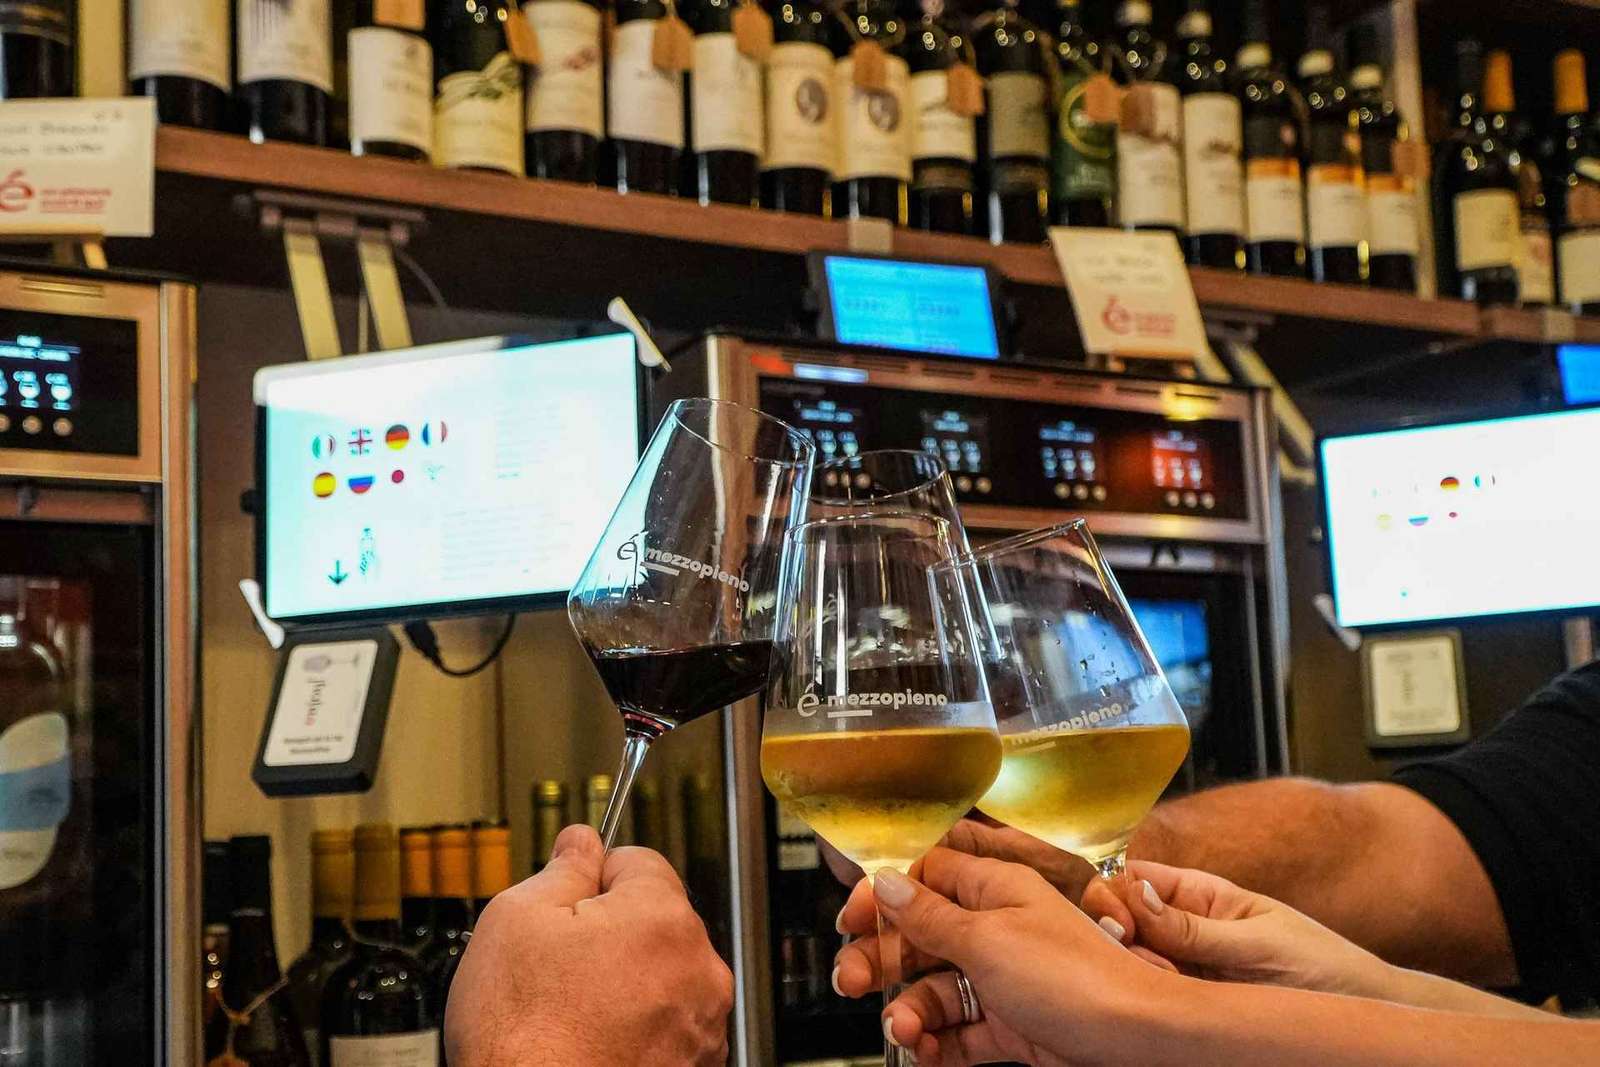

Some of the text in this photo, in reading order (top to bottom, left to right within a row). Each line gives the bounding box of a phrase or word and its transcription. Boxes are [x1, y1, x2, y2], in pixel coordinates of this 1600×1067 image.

[644, 547, 750, 592] mezzopieno
[797, 680, 949, 718] é mezzopieno
